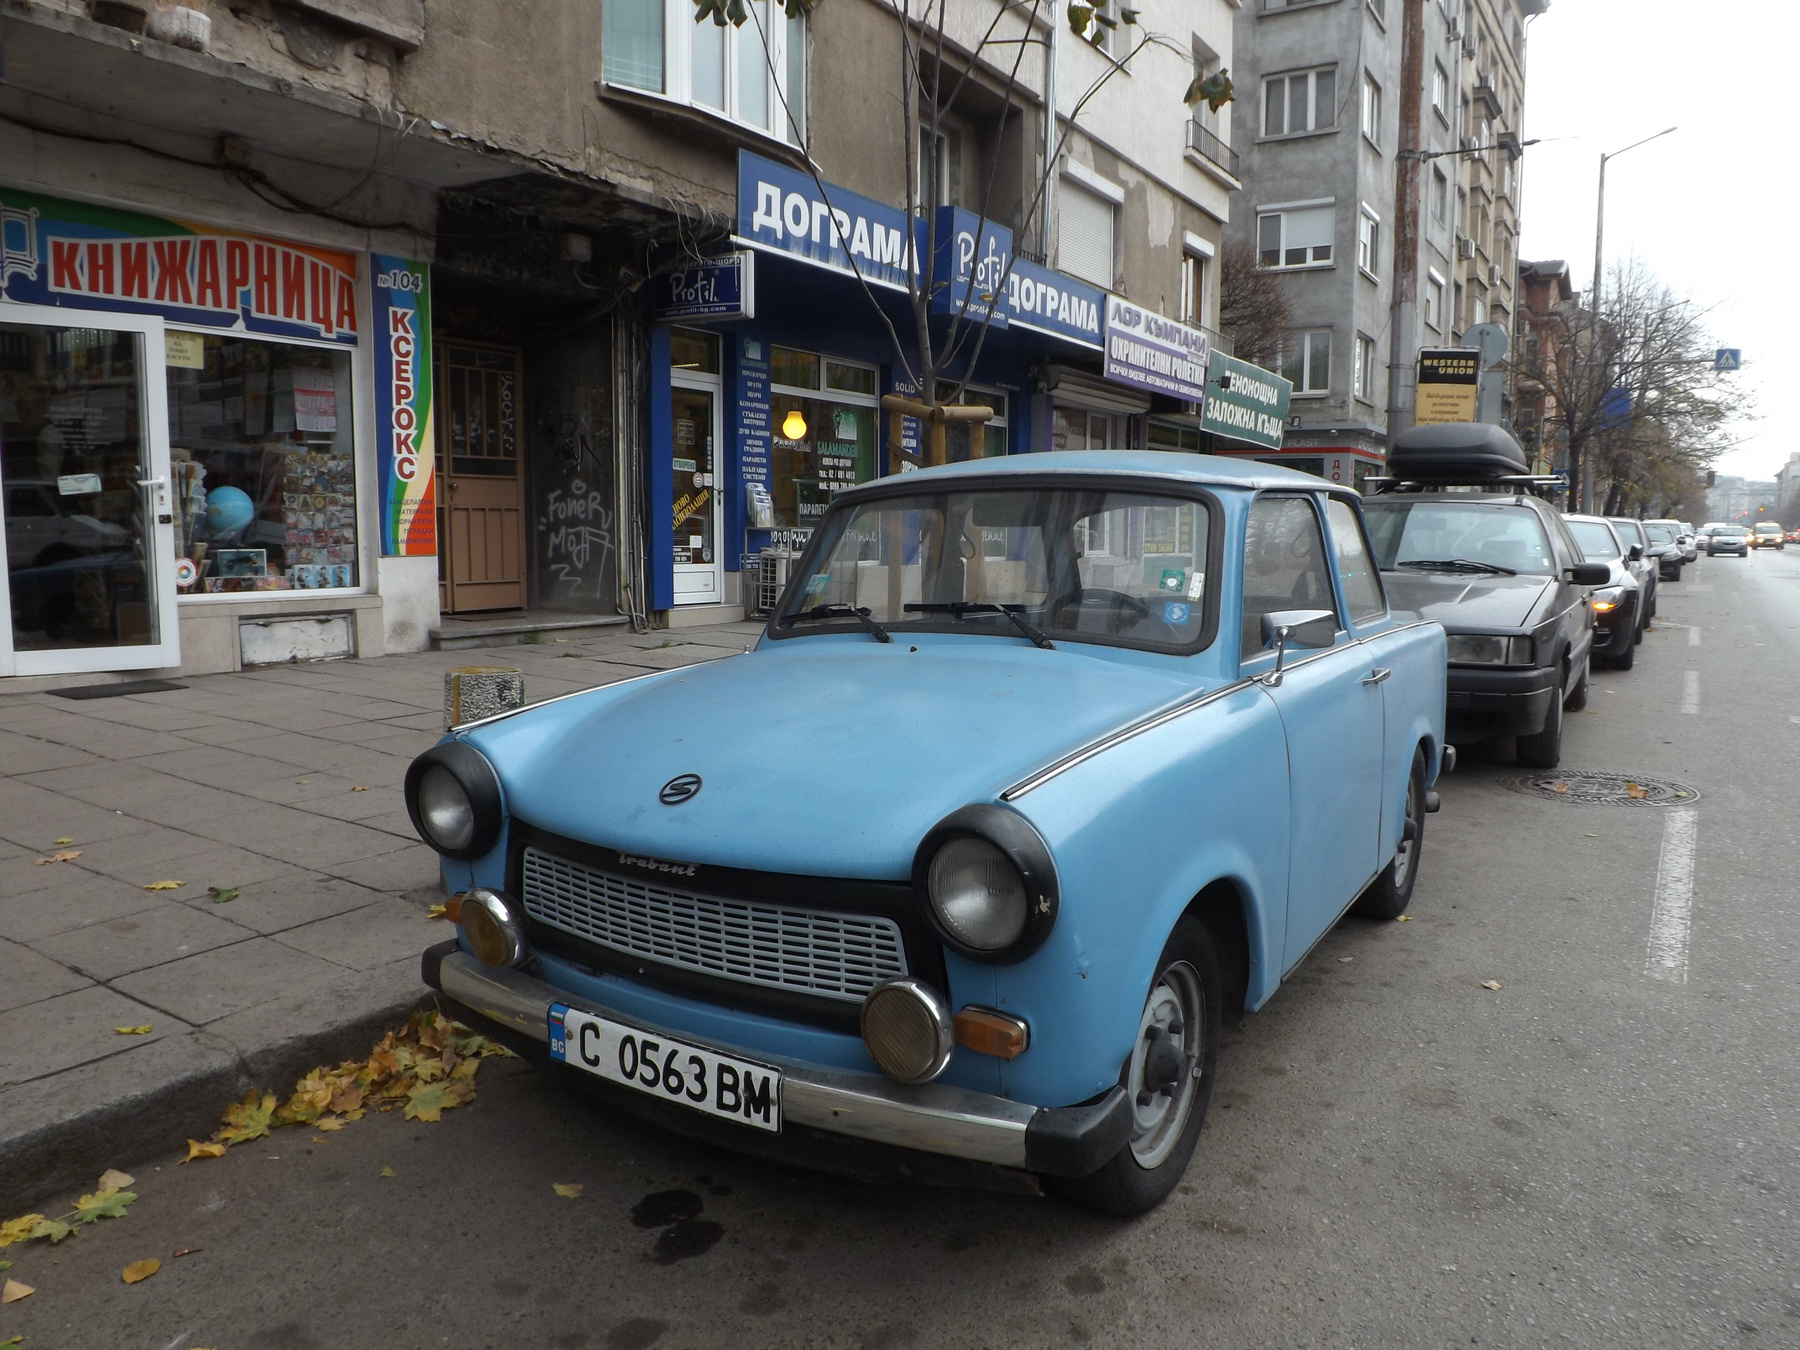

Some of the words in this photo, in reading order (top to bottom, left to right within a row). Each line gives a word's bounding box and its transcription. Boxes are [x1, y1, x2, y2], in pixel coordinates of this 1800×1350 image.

[752, 180, 921, 275] ДОГРАМА
[52, 238, 357, 335] КНИЖАРНИЦА
[669, 270, 716, 304] Profil
[1008, 272, 1099, 334] ДОГРАМА
[1144, 314, 1206, 354] КЪМПАНИ
[1109, 363, 1128, 377] ВСИЧКИ
[1128, 369, 1145, 382] ВИДОВЕ
[1110, 335, 1172, 377] ОХРАНИТЕЛНИ
[1423, 358, 1475, 367] WESTERN
[1438, 367, 1474, 375] UNION
[741, 369, 767, 380] ПРОЗОРЦИ
[894, 380, 916, 394] SOLID
[390, 308, 417, 480] КСЕРОКС
[1206, 396, 1255, 431] ЗАЛОЖНА
[1257, 412, 1283, 440] КЪЩА
[1287, 438, 1319, 447] PLAST
[672, 493, 690, 514] НОВО
[551, 1036, 565, 1054] BG
[579, 1021, 601, 1068] C
[618, 1033, 708, 1103] 0563
[715, 1061, 771, 1124] BM
